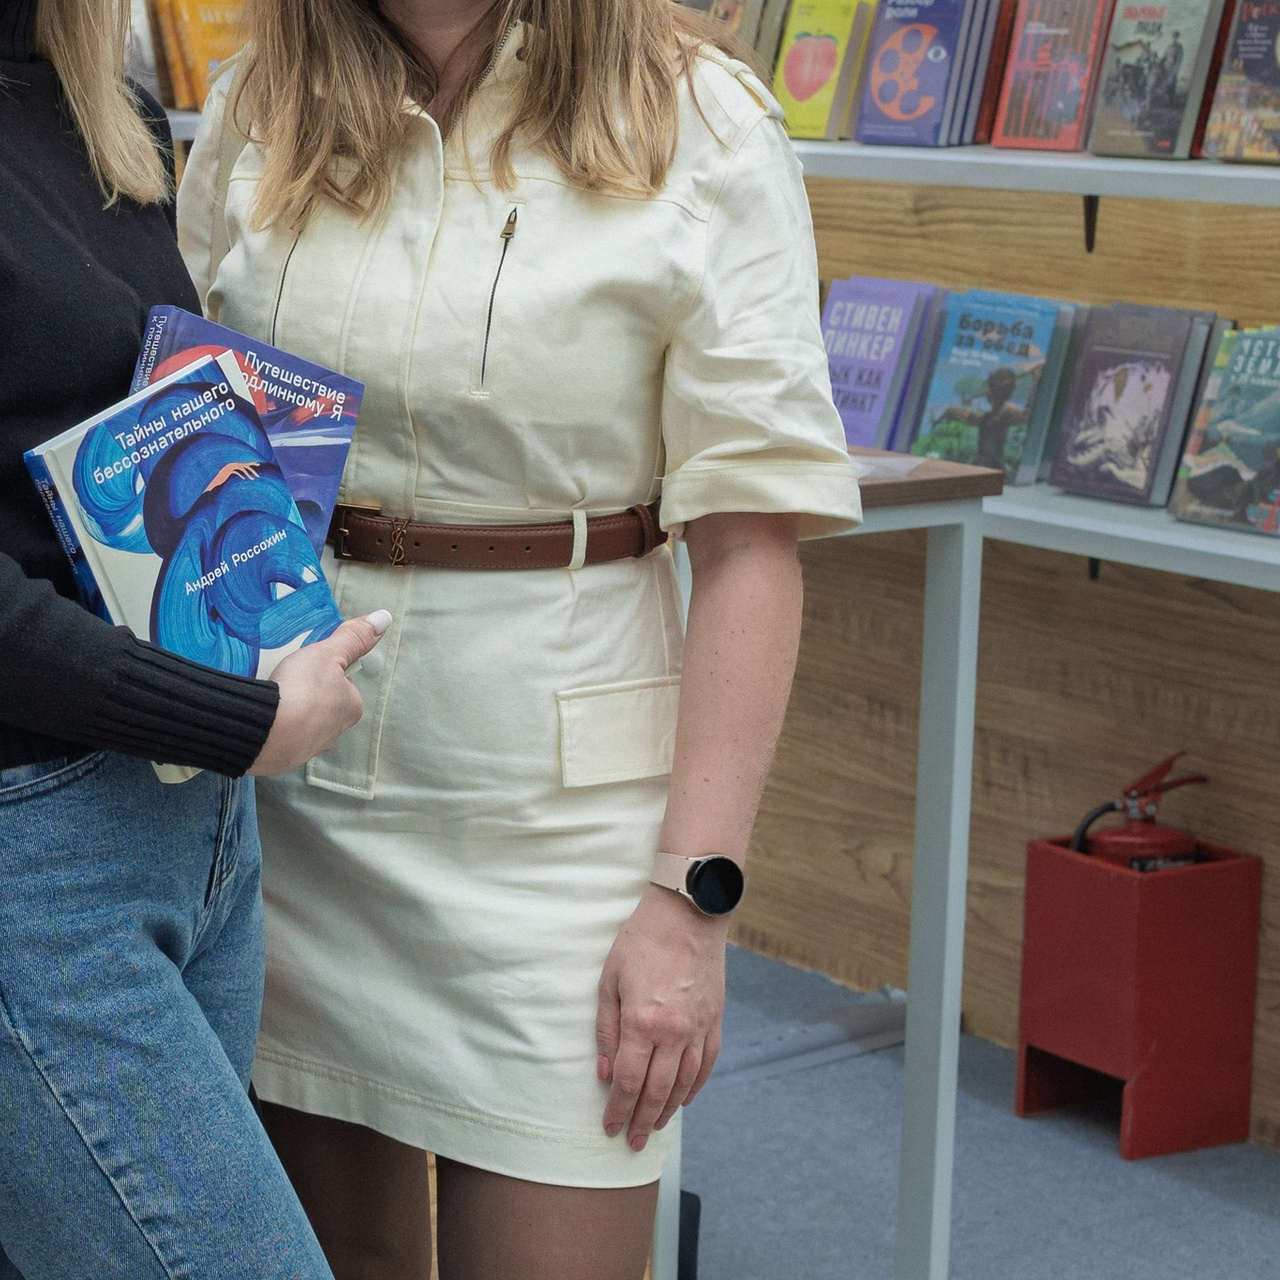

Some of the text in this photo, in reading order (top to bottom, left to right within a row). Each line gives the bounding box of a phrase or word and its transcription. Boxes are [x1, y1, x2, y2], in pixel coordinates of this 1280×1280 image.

[142, 315, 168, 387] Путешествие
[829, 301, 904, 333] СТИВЕН
[243, 350, 346, 404] Путешествие
[93, 397, 236, 485] бессознательного
[115, 380, 230, 452] Тайны нашего
[330, 404, 344, 422] Я
[40, 477, 77, 554] Тайны нашего
[185, 528, 288, 596] Андрей Россохин
